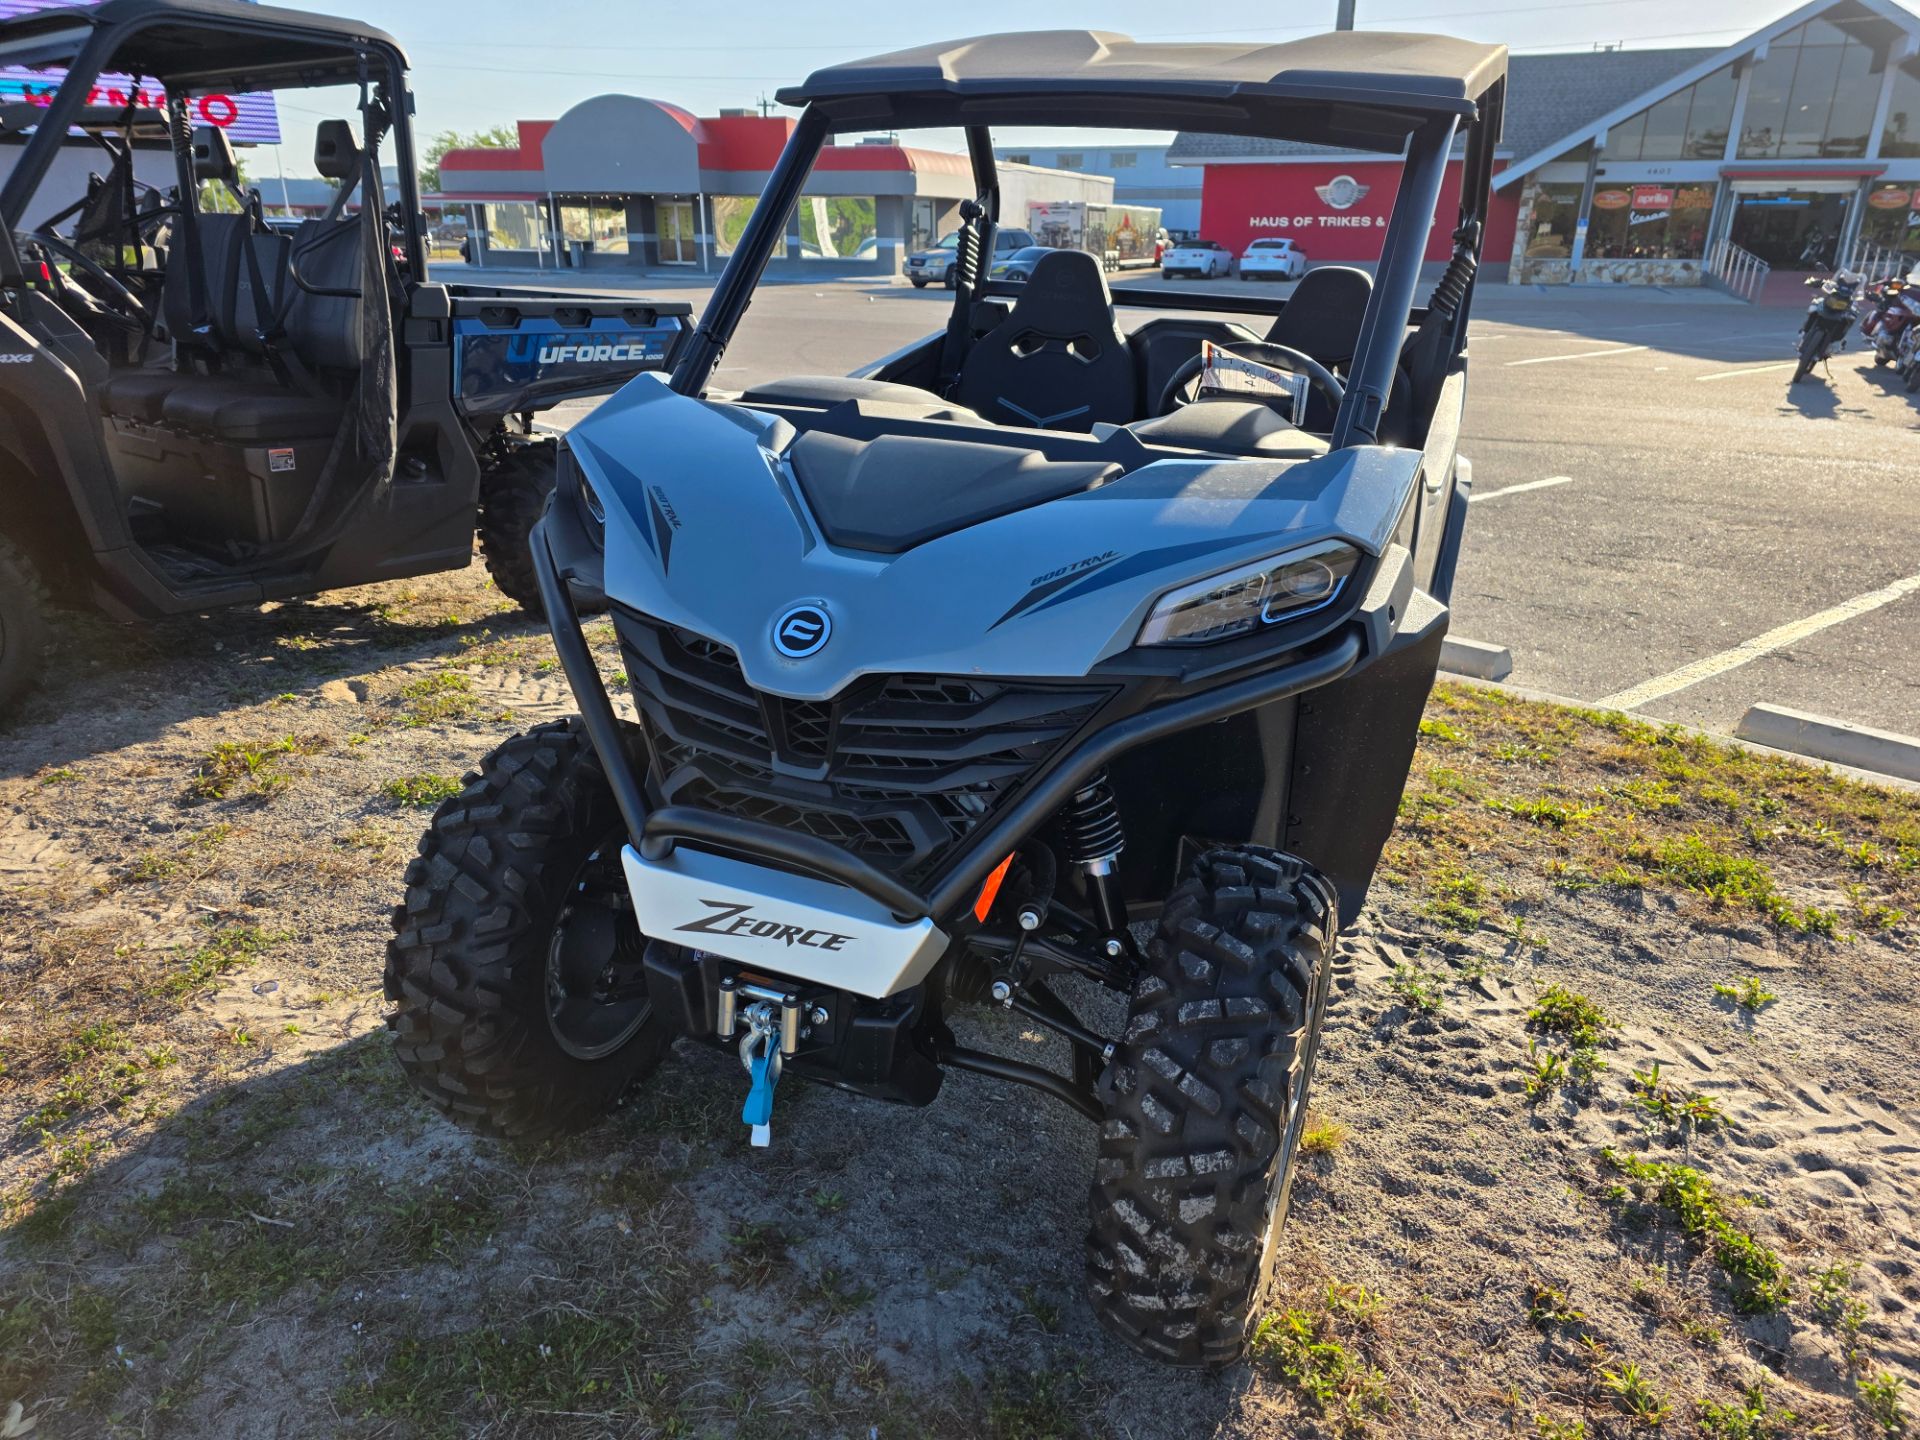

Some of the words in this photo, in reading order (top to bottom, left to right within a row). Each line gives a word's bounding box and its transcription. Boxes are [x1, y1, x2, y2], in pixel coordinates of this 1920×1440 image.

[1250, 216, 1289, 227] HAUS
[1293, 216, 1314, 227] OF
[1318, 216, 1371, 227] TRIKES
[1375, 216, 1386, 227] &
[538, 344, 646, 364] UFORCE
[672, 898, 859, 952] ZFORCE
